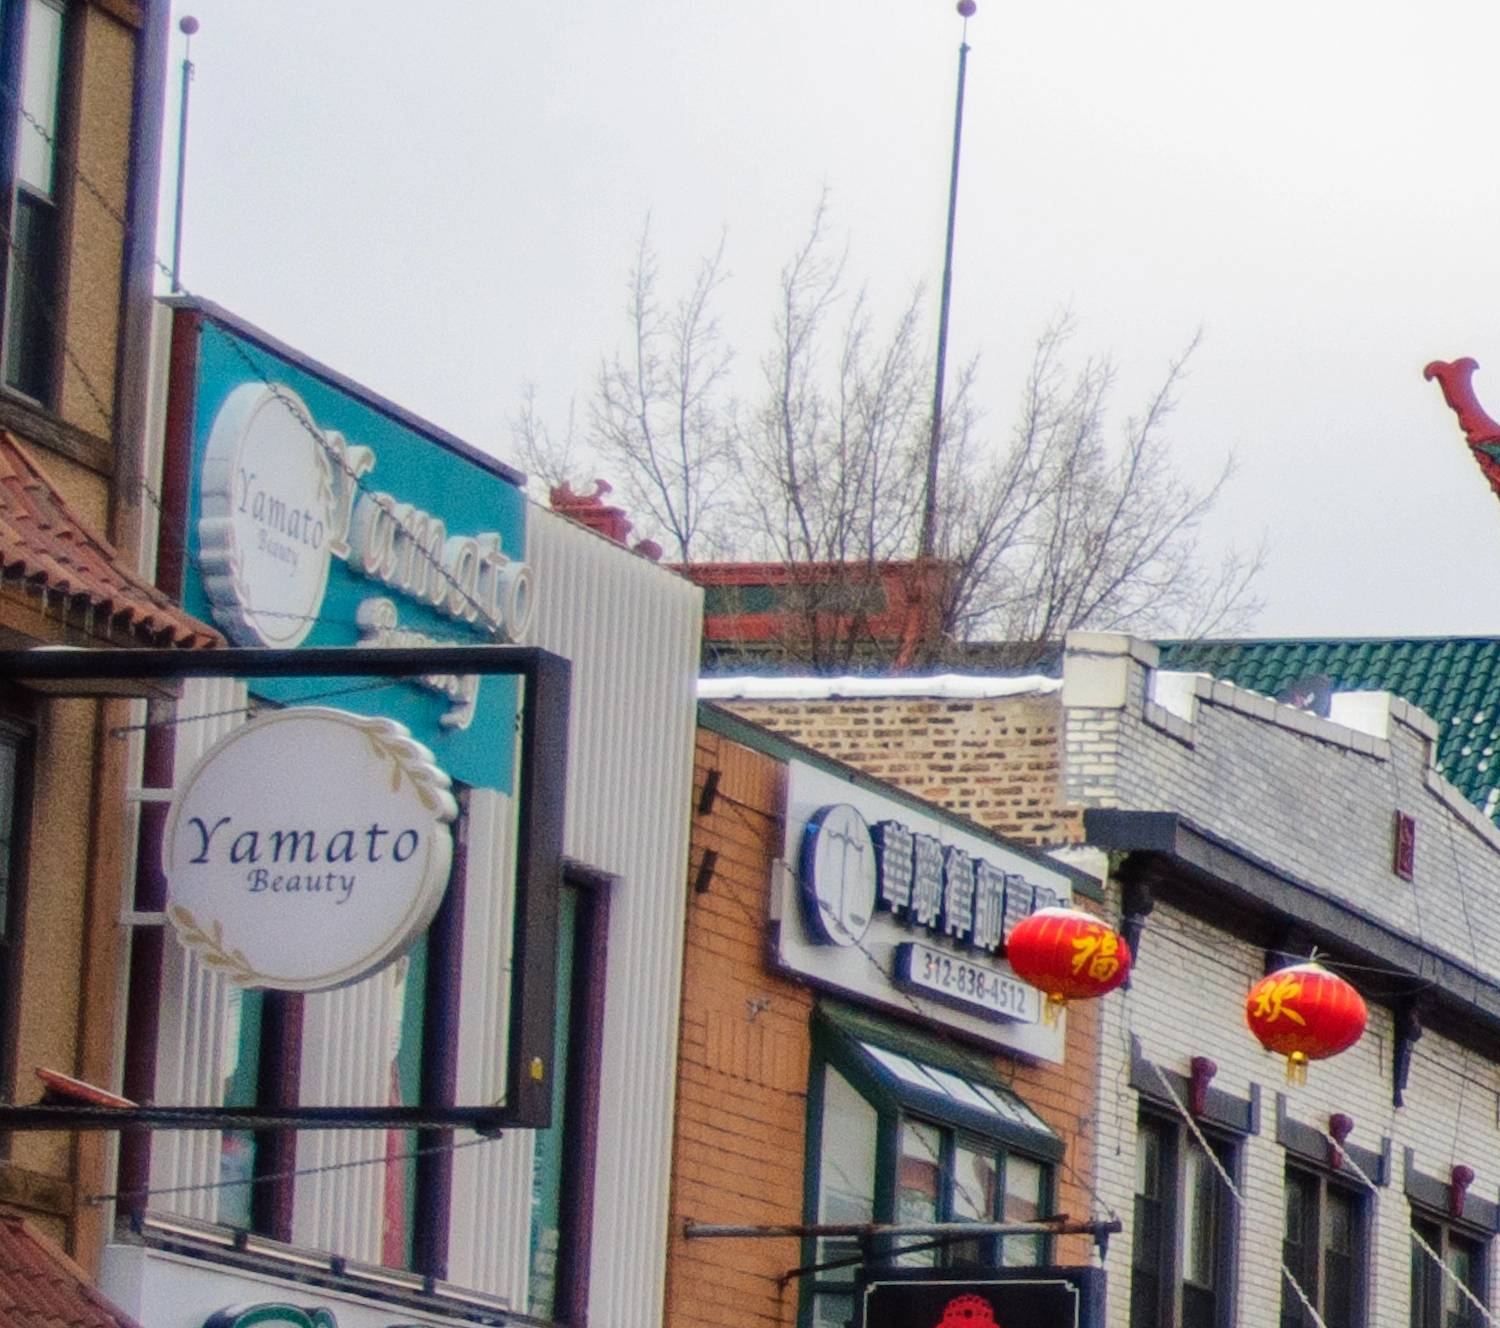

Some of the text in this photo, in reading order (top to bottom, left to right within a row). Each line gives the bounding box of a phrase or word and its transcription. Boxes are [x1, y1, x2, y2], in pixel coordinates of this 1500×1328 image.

[186, 816, 421, 867] Yamato
[246, 867, 358, 904] Beauty
[1071, 923, 1121, 983] 福
[922, 952, 1028, 1015] 312-838-4512
